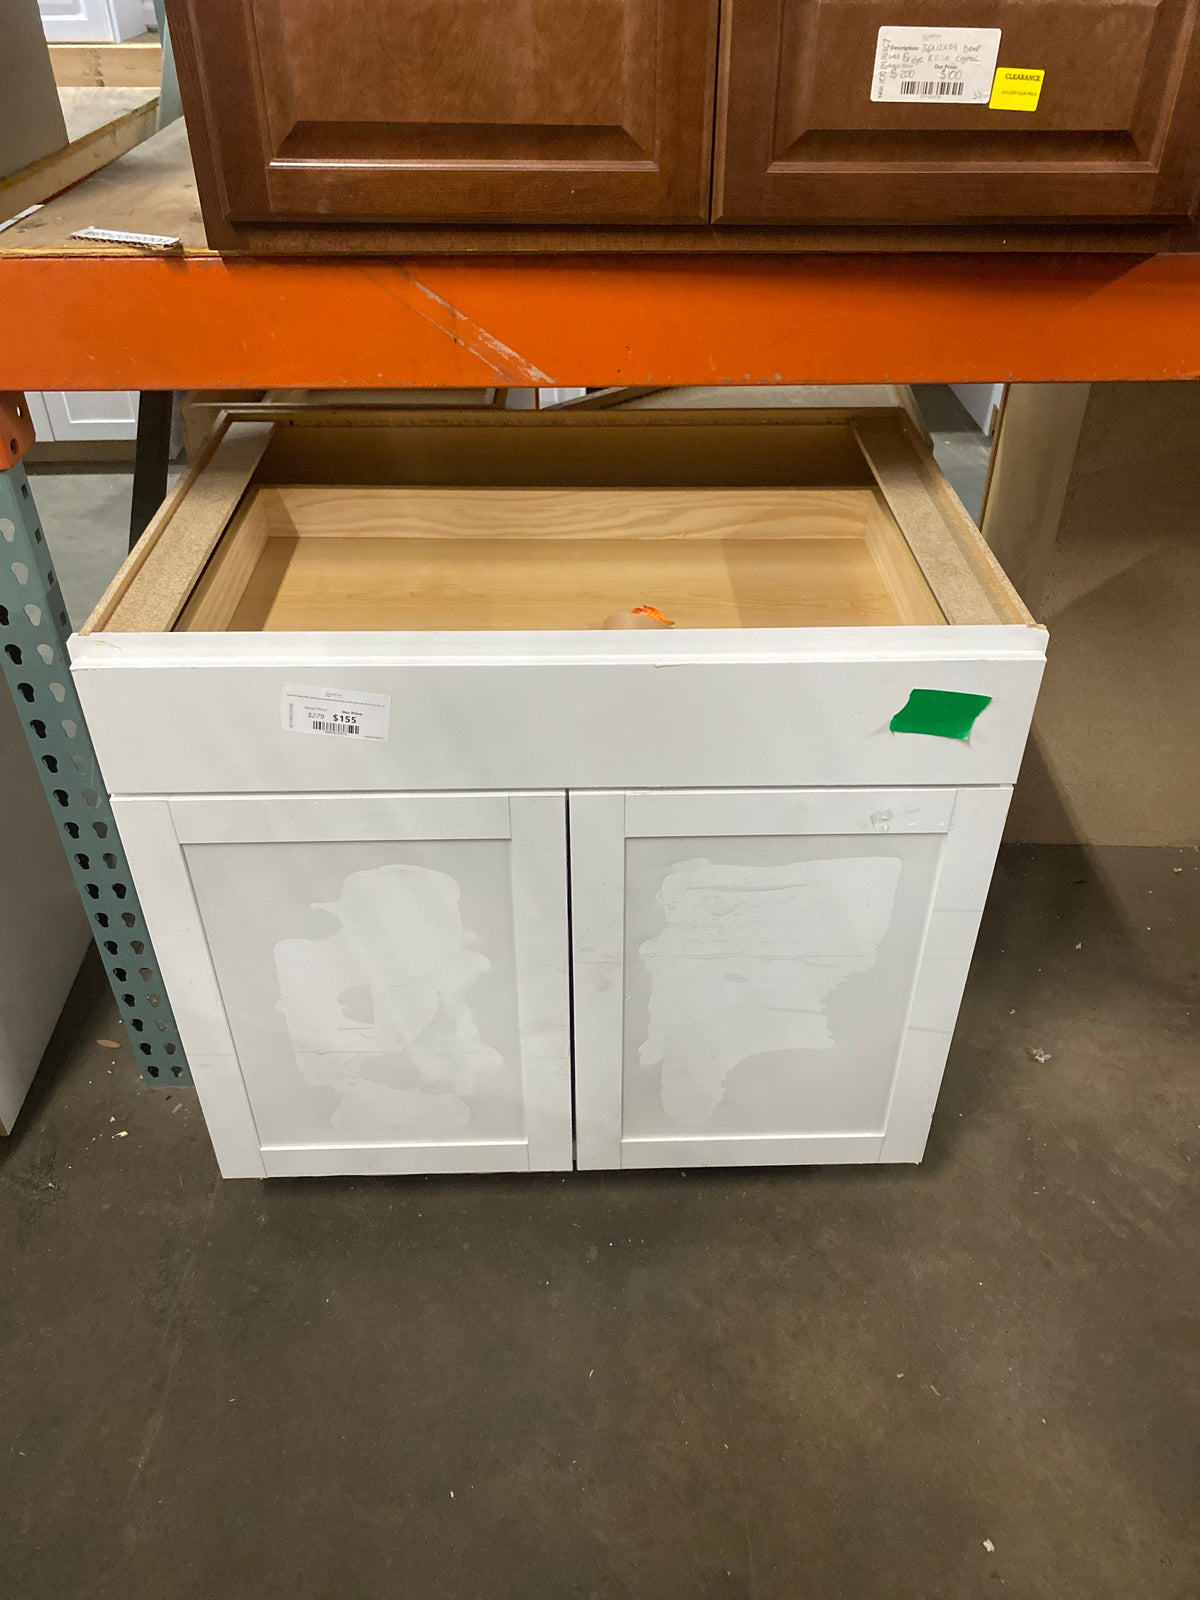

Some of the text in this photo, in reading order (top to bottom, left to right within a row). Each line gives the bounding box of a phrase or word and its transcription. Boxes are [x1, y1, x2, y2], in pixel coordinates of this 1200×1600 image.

[1005, 73, 1041, 81] CLEARANCE
[307, 712, 325, 720] $279
[332, 713, 357, 724] $155
